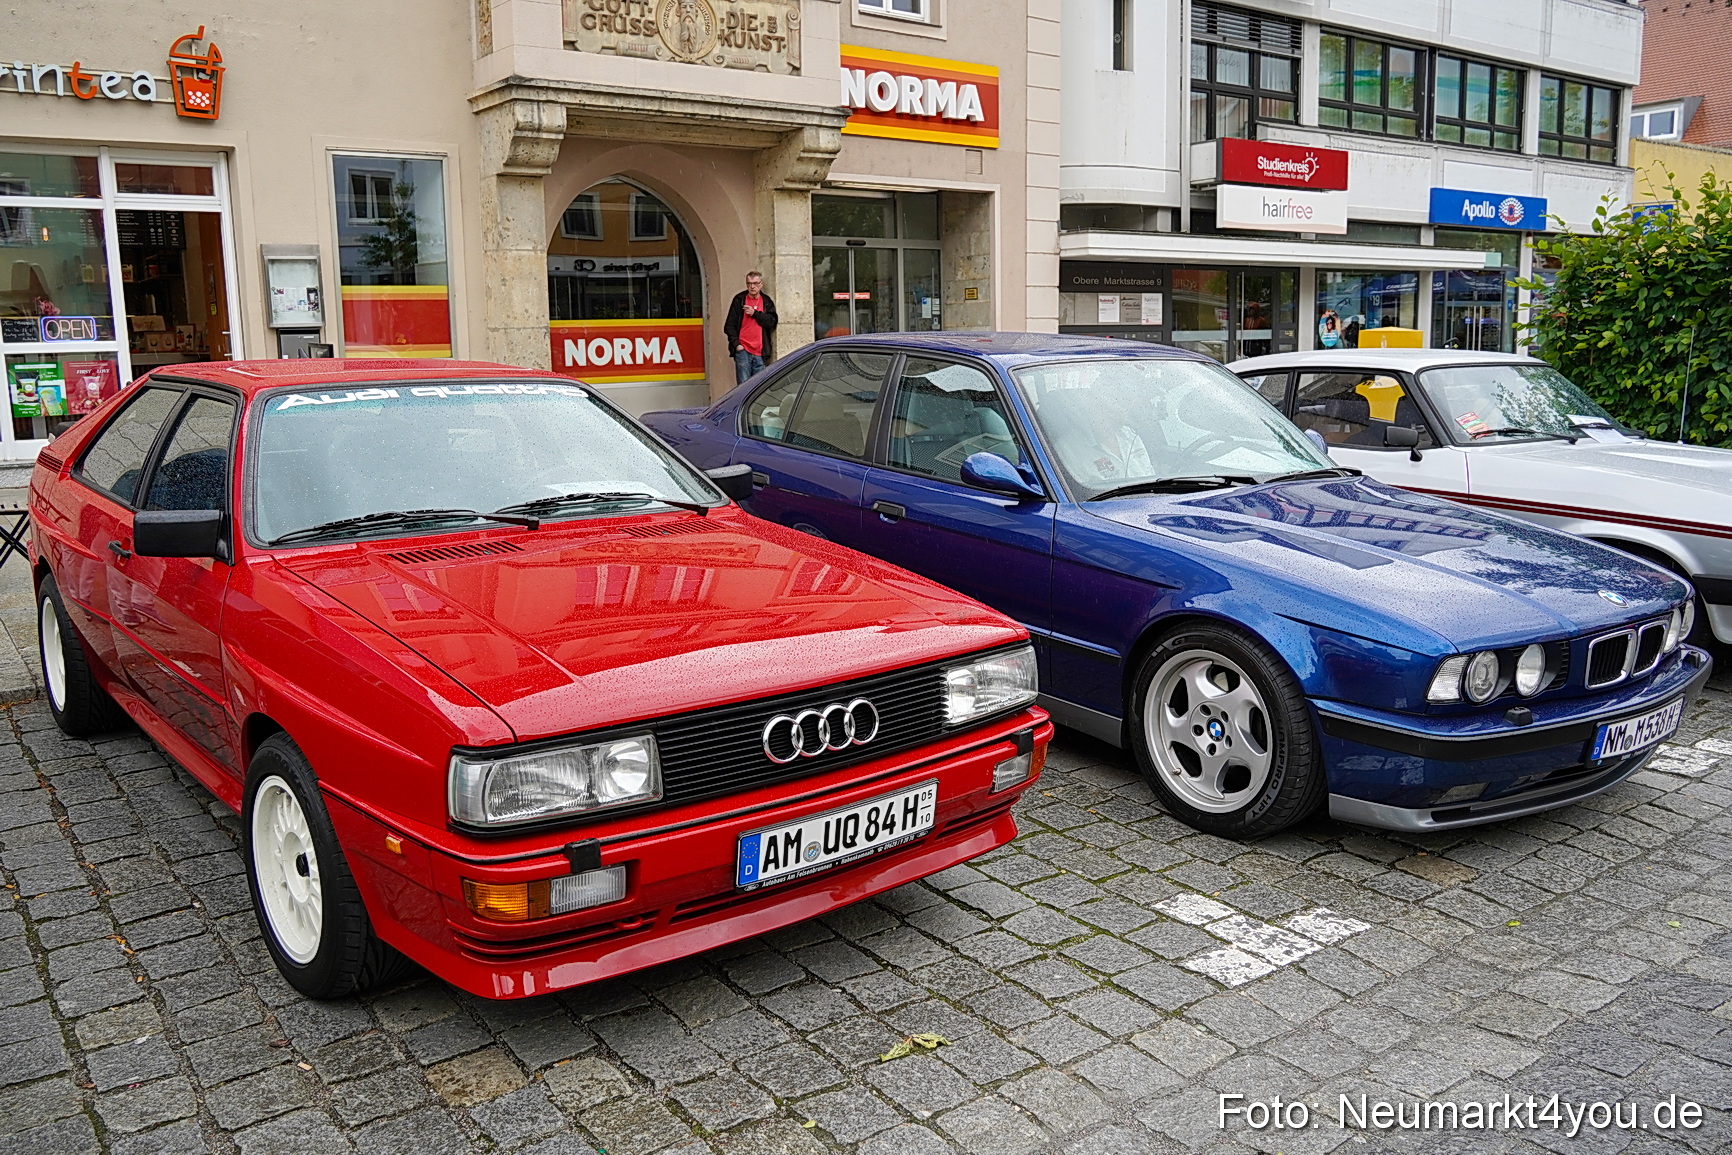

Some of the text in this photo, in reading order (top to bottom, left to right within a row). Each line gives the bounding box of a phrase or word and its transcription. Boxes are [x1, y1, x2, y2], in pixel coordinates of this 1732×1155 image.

[840, 66, 985, 122] NORMA
[1257, 156, 1309, 173] Studienkreis
[1263, 196, 1313, 219] hairfree
[1462, 199, 1496, 221] Apollo
[1073, 276, 1162, 286] Obere Marktstrasse 9
[46, 320, 94, 339] OPEN
[564, 336, 683, 367] NORMA
[276, 388, 400, 410] Audi
[1602, 723, 1628, 755] NM
[921, 789, 933, 802] 05
[920, 812, 931, 825] 10
[762, 828, 803, 873] AM
[823, 813, 860, 856] UQ
[744, 864, 753, 876] D
[762, 877, 786, 887] Autohaus
